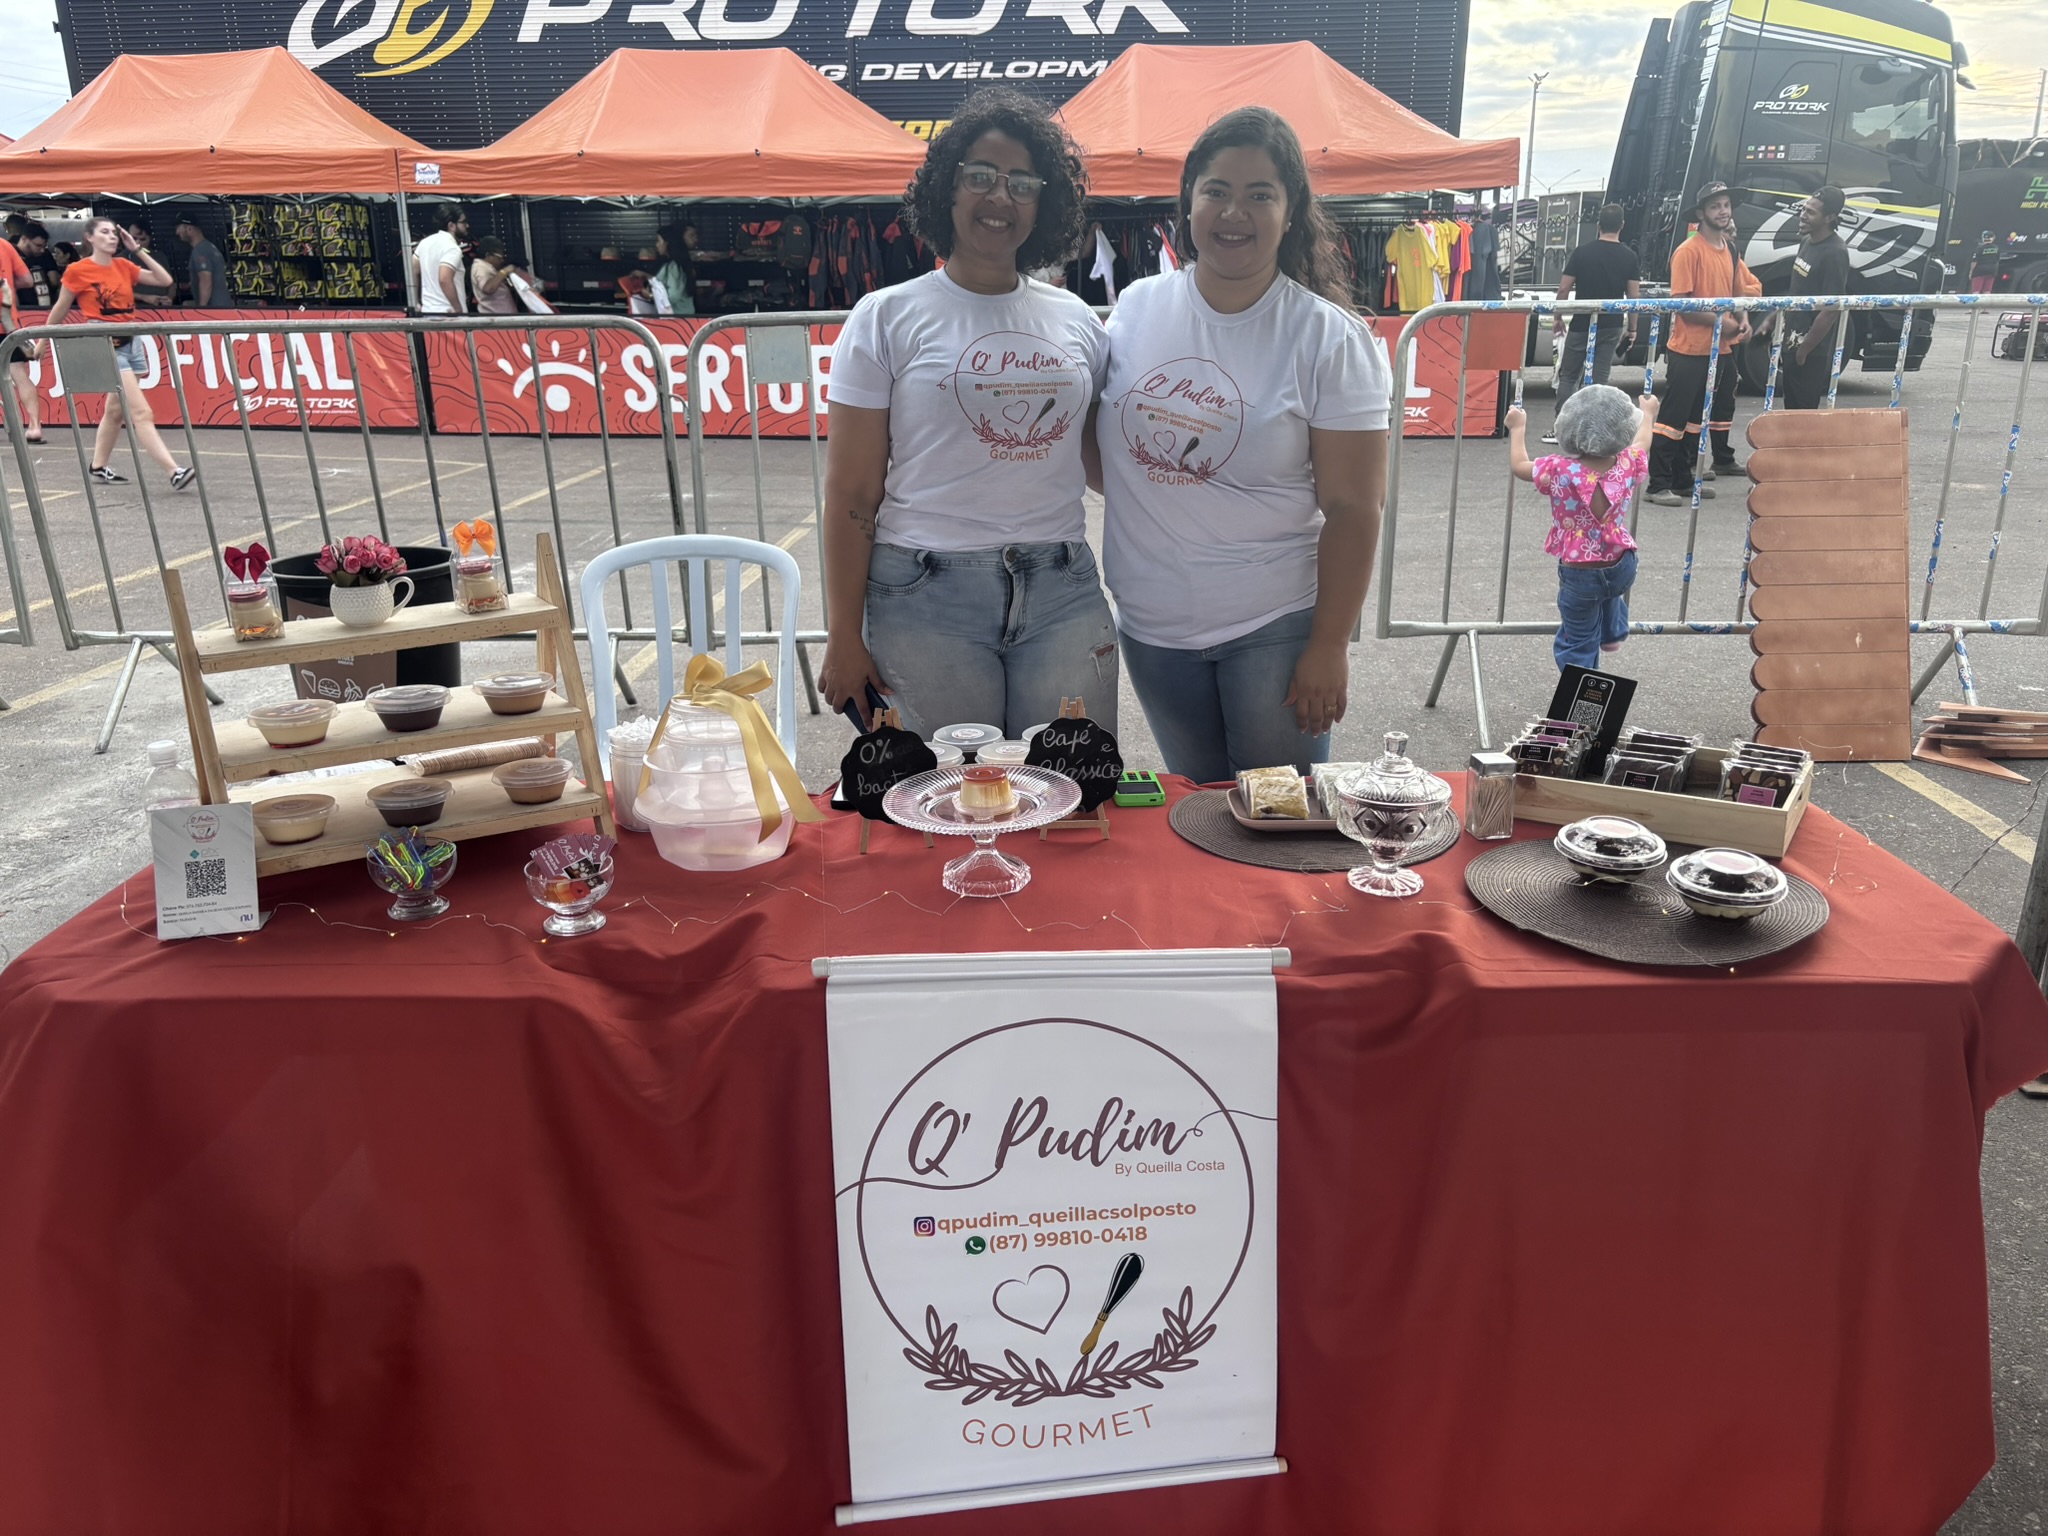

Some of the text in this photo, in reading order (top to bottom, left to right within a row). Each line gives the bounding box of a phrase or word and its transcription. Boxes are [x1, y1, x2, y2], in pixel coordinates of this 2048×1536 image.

[861, 60, 1112, 81] DEVELOPM
[1753, 101, 1830, 111] PRO TORK
[1001, 350, 1063, 371] Pudim
[265, 397, 357, 408] PRO TORK
[1168, 378, 1226, 409] Pudim
[990, 448, 1050, 462] GOURMET
[1147, 471, 1204, 486] GOURME
[1042, 723, 1114, 754] Café e
[860, 739, 893, 764] 0%
[908, 1096, 1189, 1178] Q' Pudim
[1115, 1160, 1225, 1177] By Queilla Costa
[937, 1202, 1197, 1234] qpudim_queillacsolposto
[989, 1226, 1148, 1253] (87) 99810-0418
[962, 1403, 1154, 1449] GOURMET
